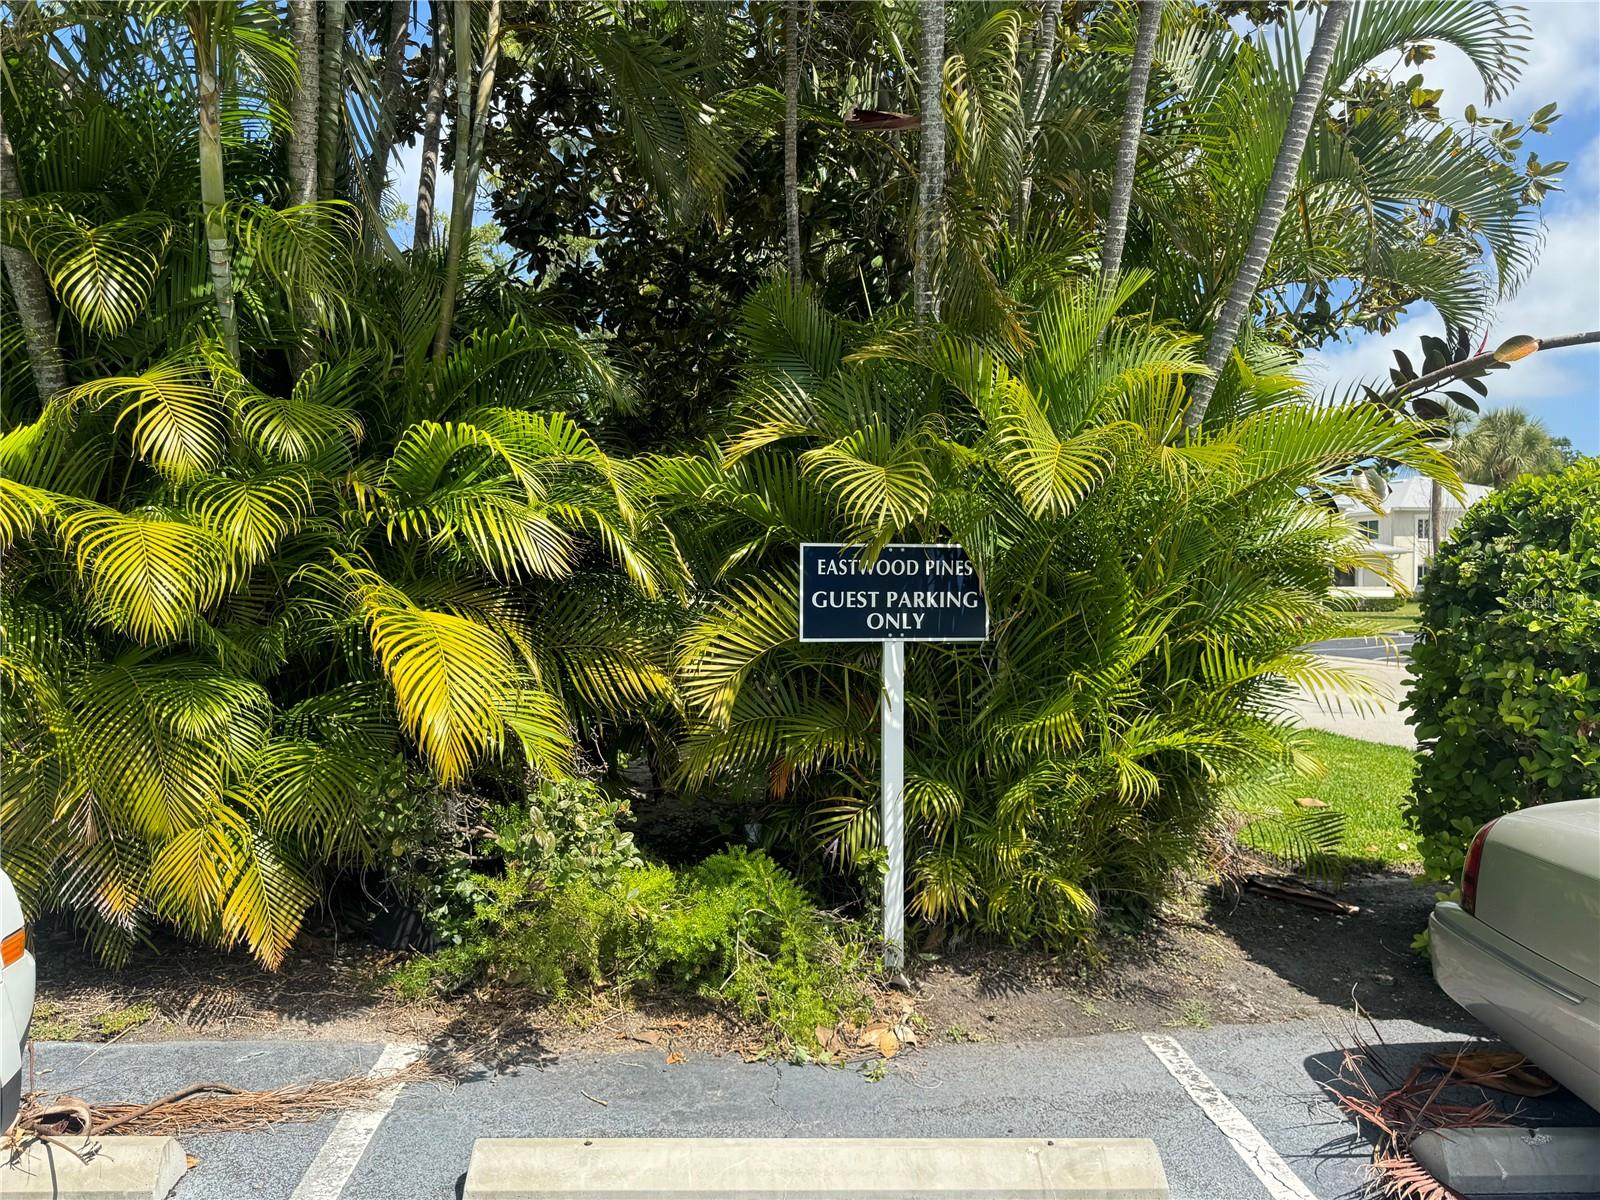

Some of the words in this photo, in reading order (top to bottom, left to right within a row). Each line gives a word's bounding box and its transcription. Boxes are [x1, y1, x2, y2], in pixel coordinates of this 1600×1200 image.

[925, 559, 973, 576] PINES
[811, 591, 879, 608] GUEST
[886, 591, 978, 608] PARKING
[866, 612, 925, 630] ONLY
